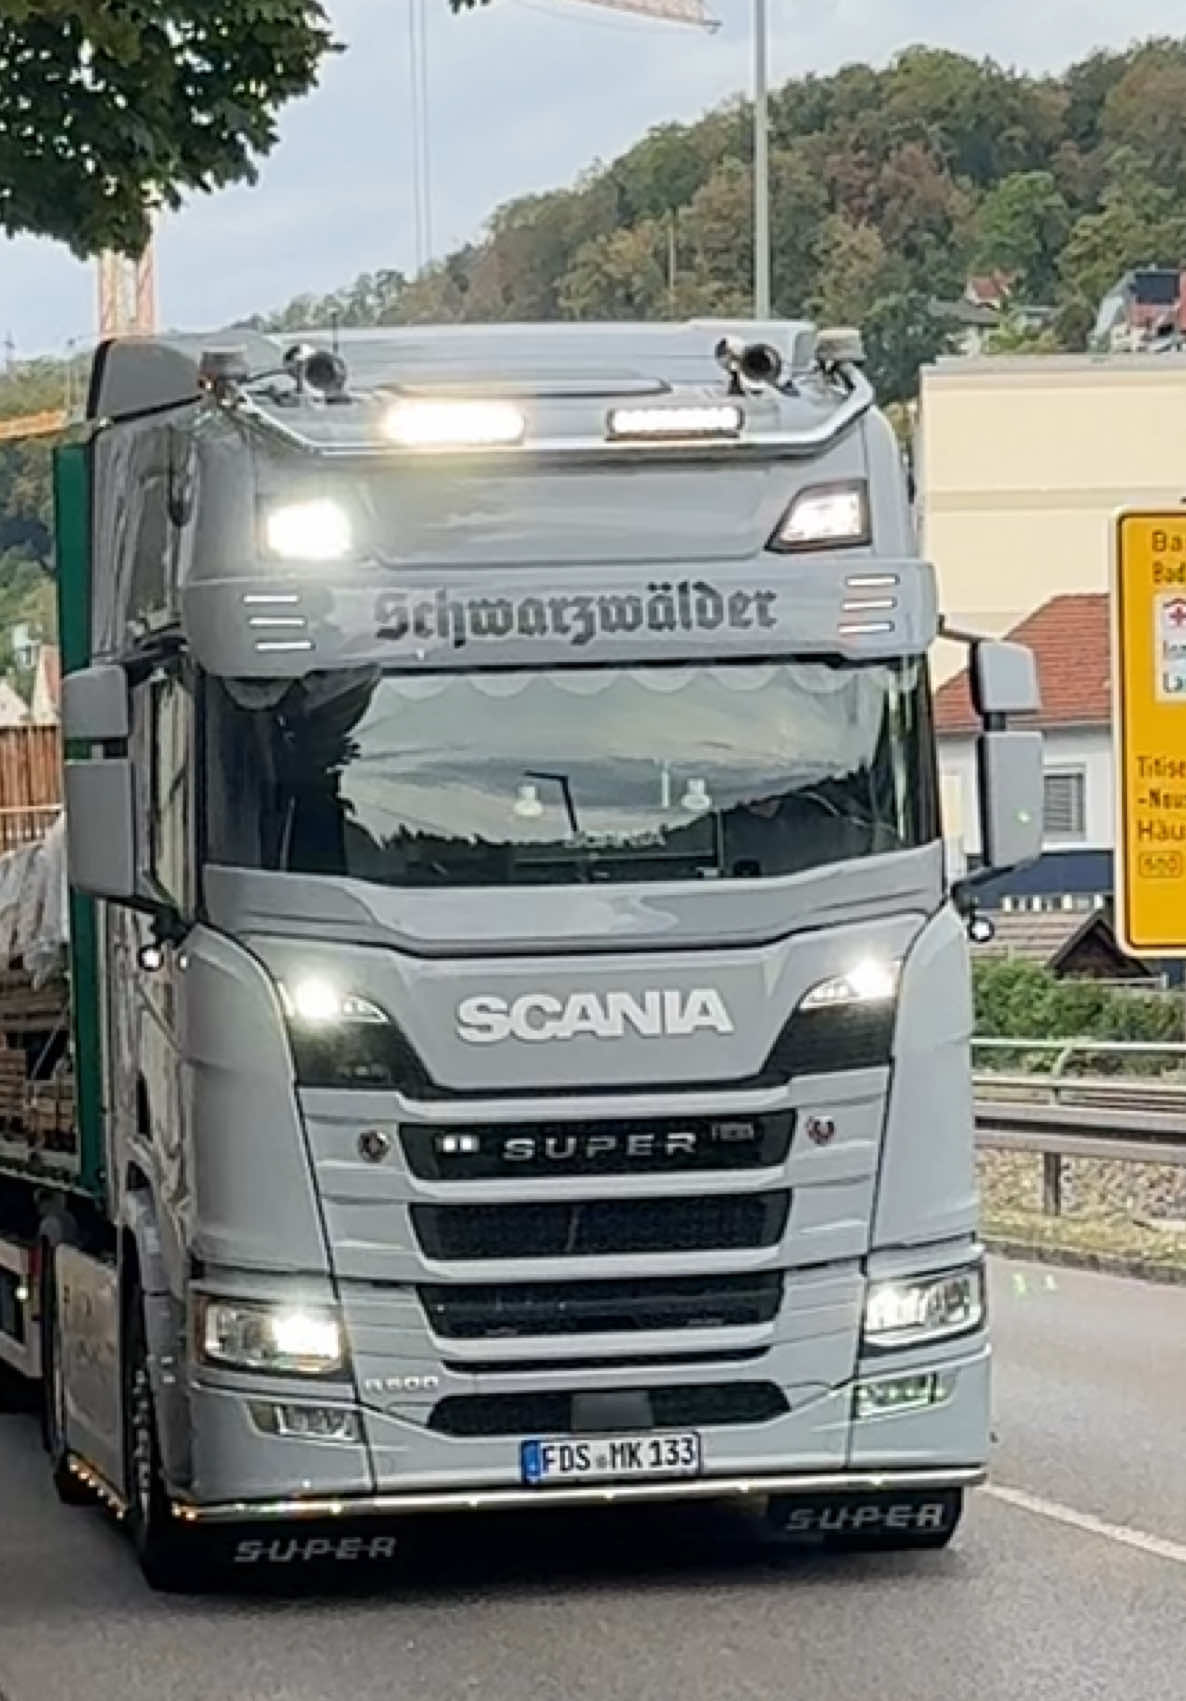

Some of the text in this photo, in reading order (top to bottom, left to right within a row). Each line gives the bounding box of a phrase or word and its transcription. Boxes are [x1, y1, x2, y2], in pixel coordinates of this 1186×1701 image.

[375, 580, 777, 648] Schwarzwälder
[456, 988, 735, 1042] SCANIA
[503, 1132, 697, 1161] SUPER
[542, 1437, 694, 1472] FDS MK 133
[785, 1503, 944, 1531] SUPER
[234, 1536, 397, 1563] SUPER
